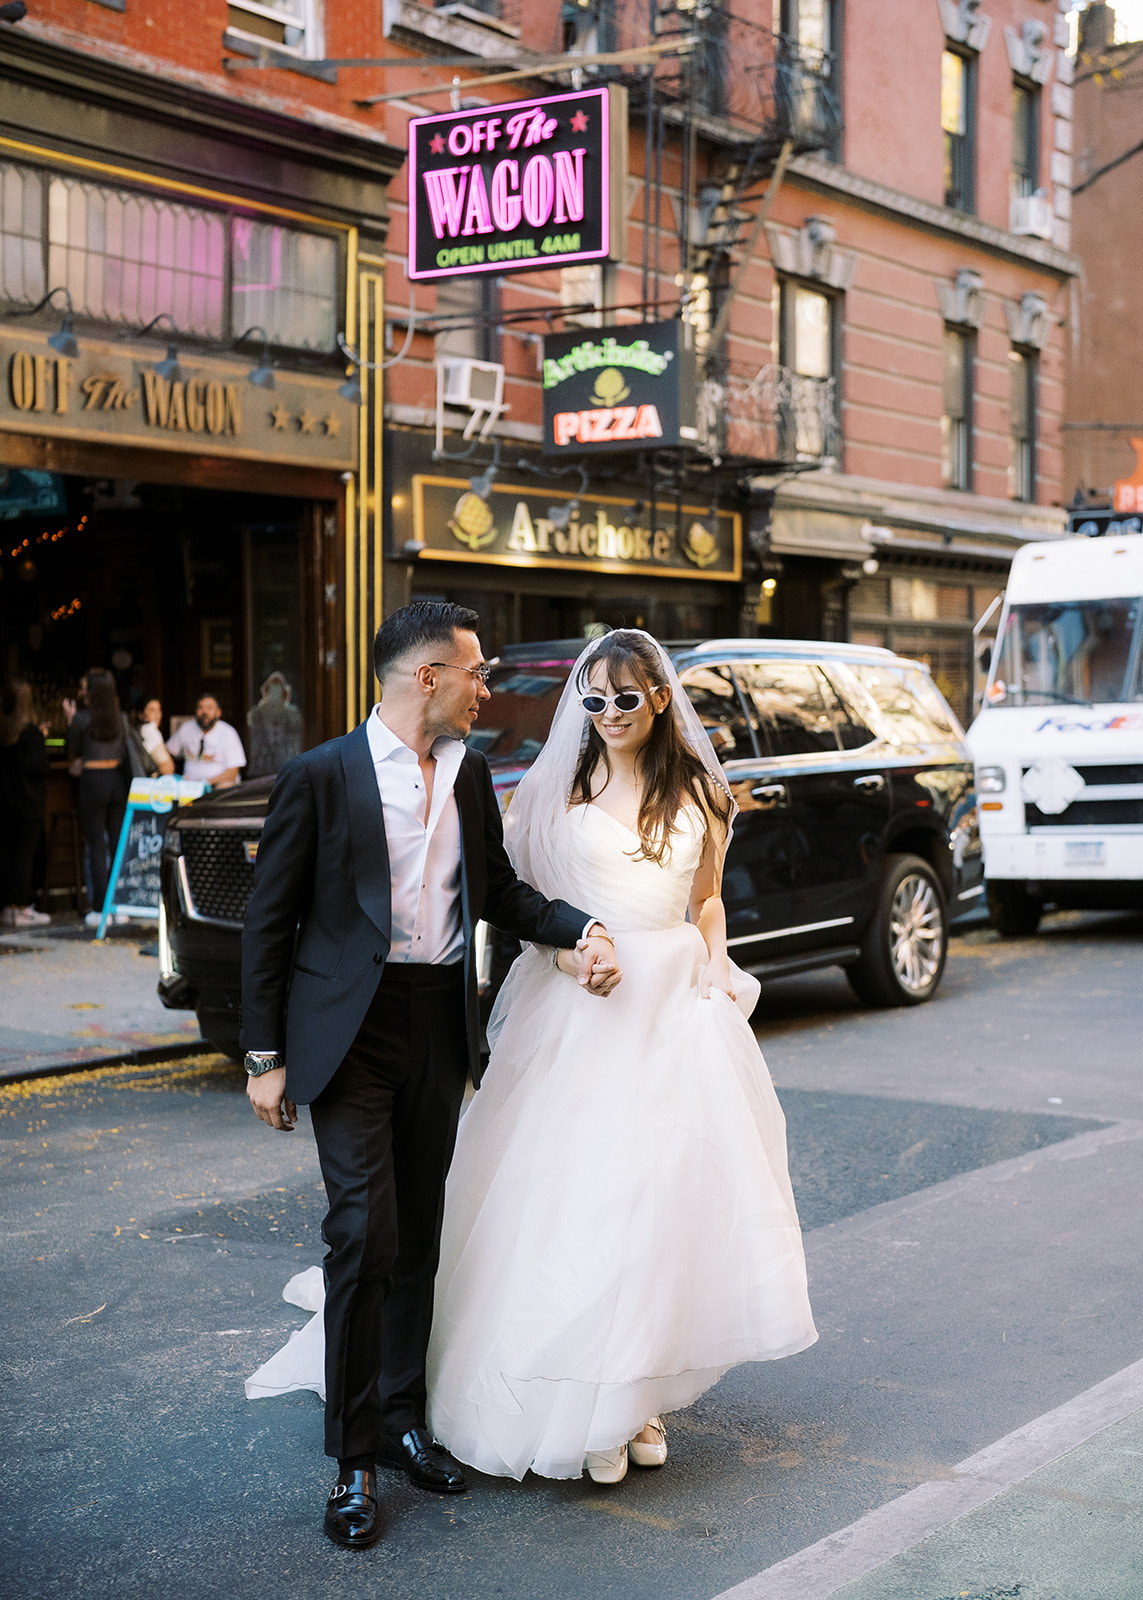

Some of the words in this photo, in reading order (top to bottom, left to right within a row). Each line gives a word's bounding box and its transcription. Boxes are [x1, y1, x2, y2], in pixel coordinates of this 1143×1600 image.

[448, 118, 502, 156] OFF
[506, 107, 558, 149] The
[422, 148, 587, 239] WAGON
[436, 245, 485, 268] OPEN
[487, 238, 539, 262] UNTIL
[540, 232, 581, 255] 4AM
[8, 350, 74, 415] OFF
[81, 373, 138, 410] The
[141, 369, 242, 436] WAGON
[553, 404, 663, 446] PIZZA
